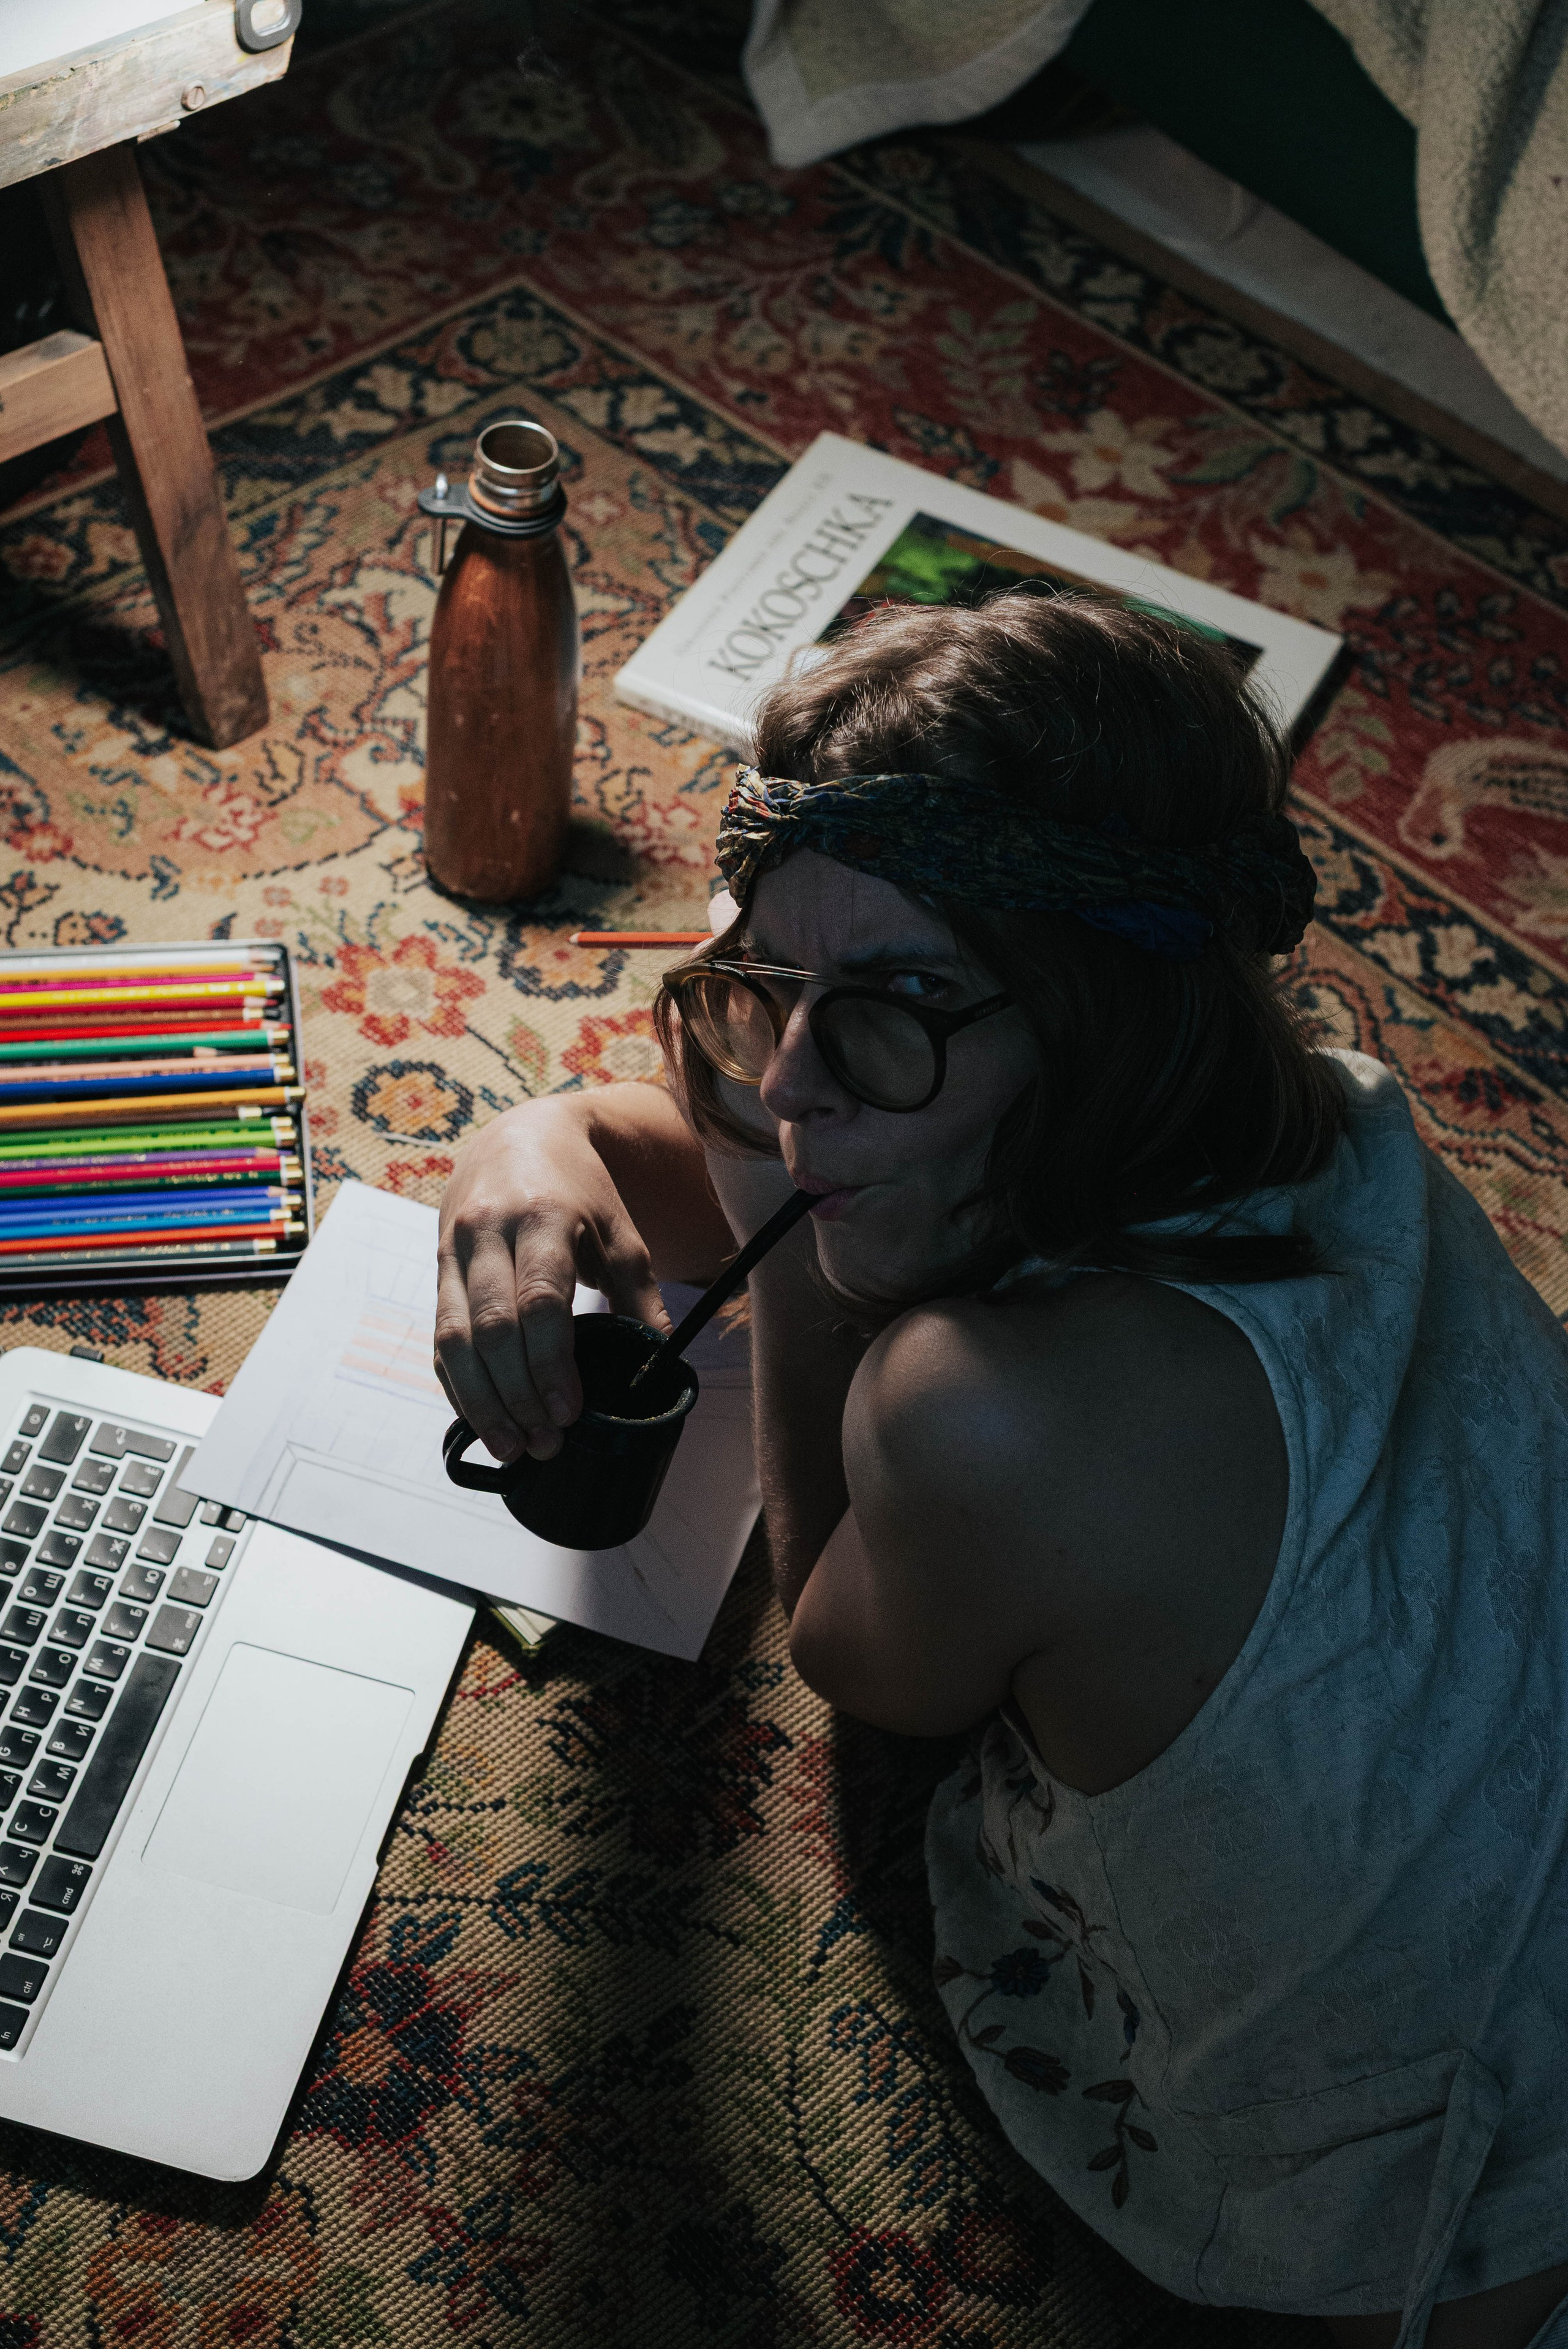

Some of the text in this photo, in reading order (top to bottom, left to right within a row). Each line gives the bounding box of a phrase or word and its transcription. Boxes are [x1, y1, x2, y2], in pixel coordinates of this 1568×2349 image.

[707, 492, 895, 682] KOKOSCHKA
[94, 1577, 110, 1590] Д
[145, 1570, 160, 1584] Ю
[70, 1698, 85, 1710] N
[52, 1741, 66, 1751] B
[33, 1779, 47, 1789] V
[62, 1887, 74, 1904] cmd
[23, 1981, 33, 1994] ctrl
[1, 2031, 11, 2040] fn
